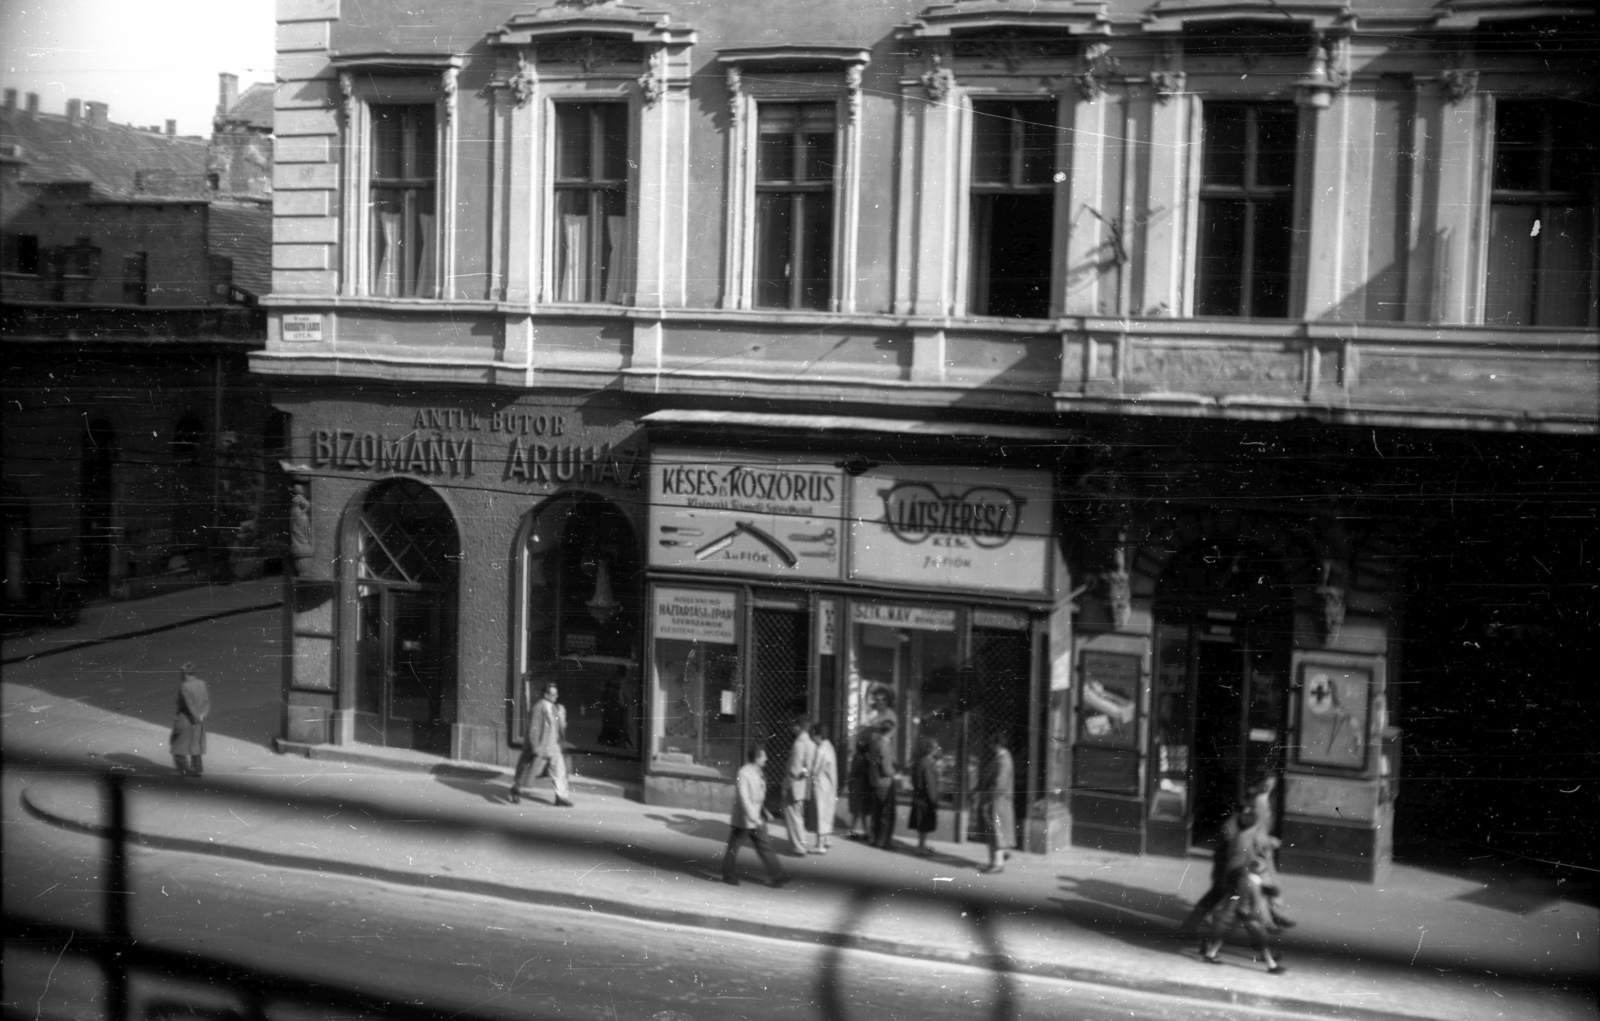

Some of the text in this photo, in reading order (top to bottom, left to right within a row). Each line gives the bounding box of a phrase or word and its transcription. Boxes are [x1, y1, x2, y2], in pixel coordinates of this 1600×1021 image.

[284, 322, 320, 332] KOSSUTH LAJOS
[413, 406, 481, 430] ANTIK
[662, 465, 718, 497] KÉSES
[899, 493, 1008, 538] LÁTSZERÉSZ
